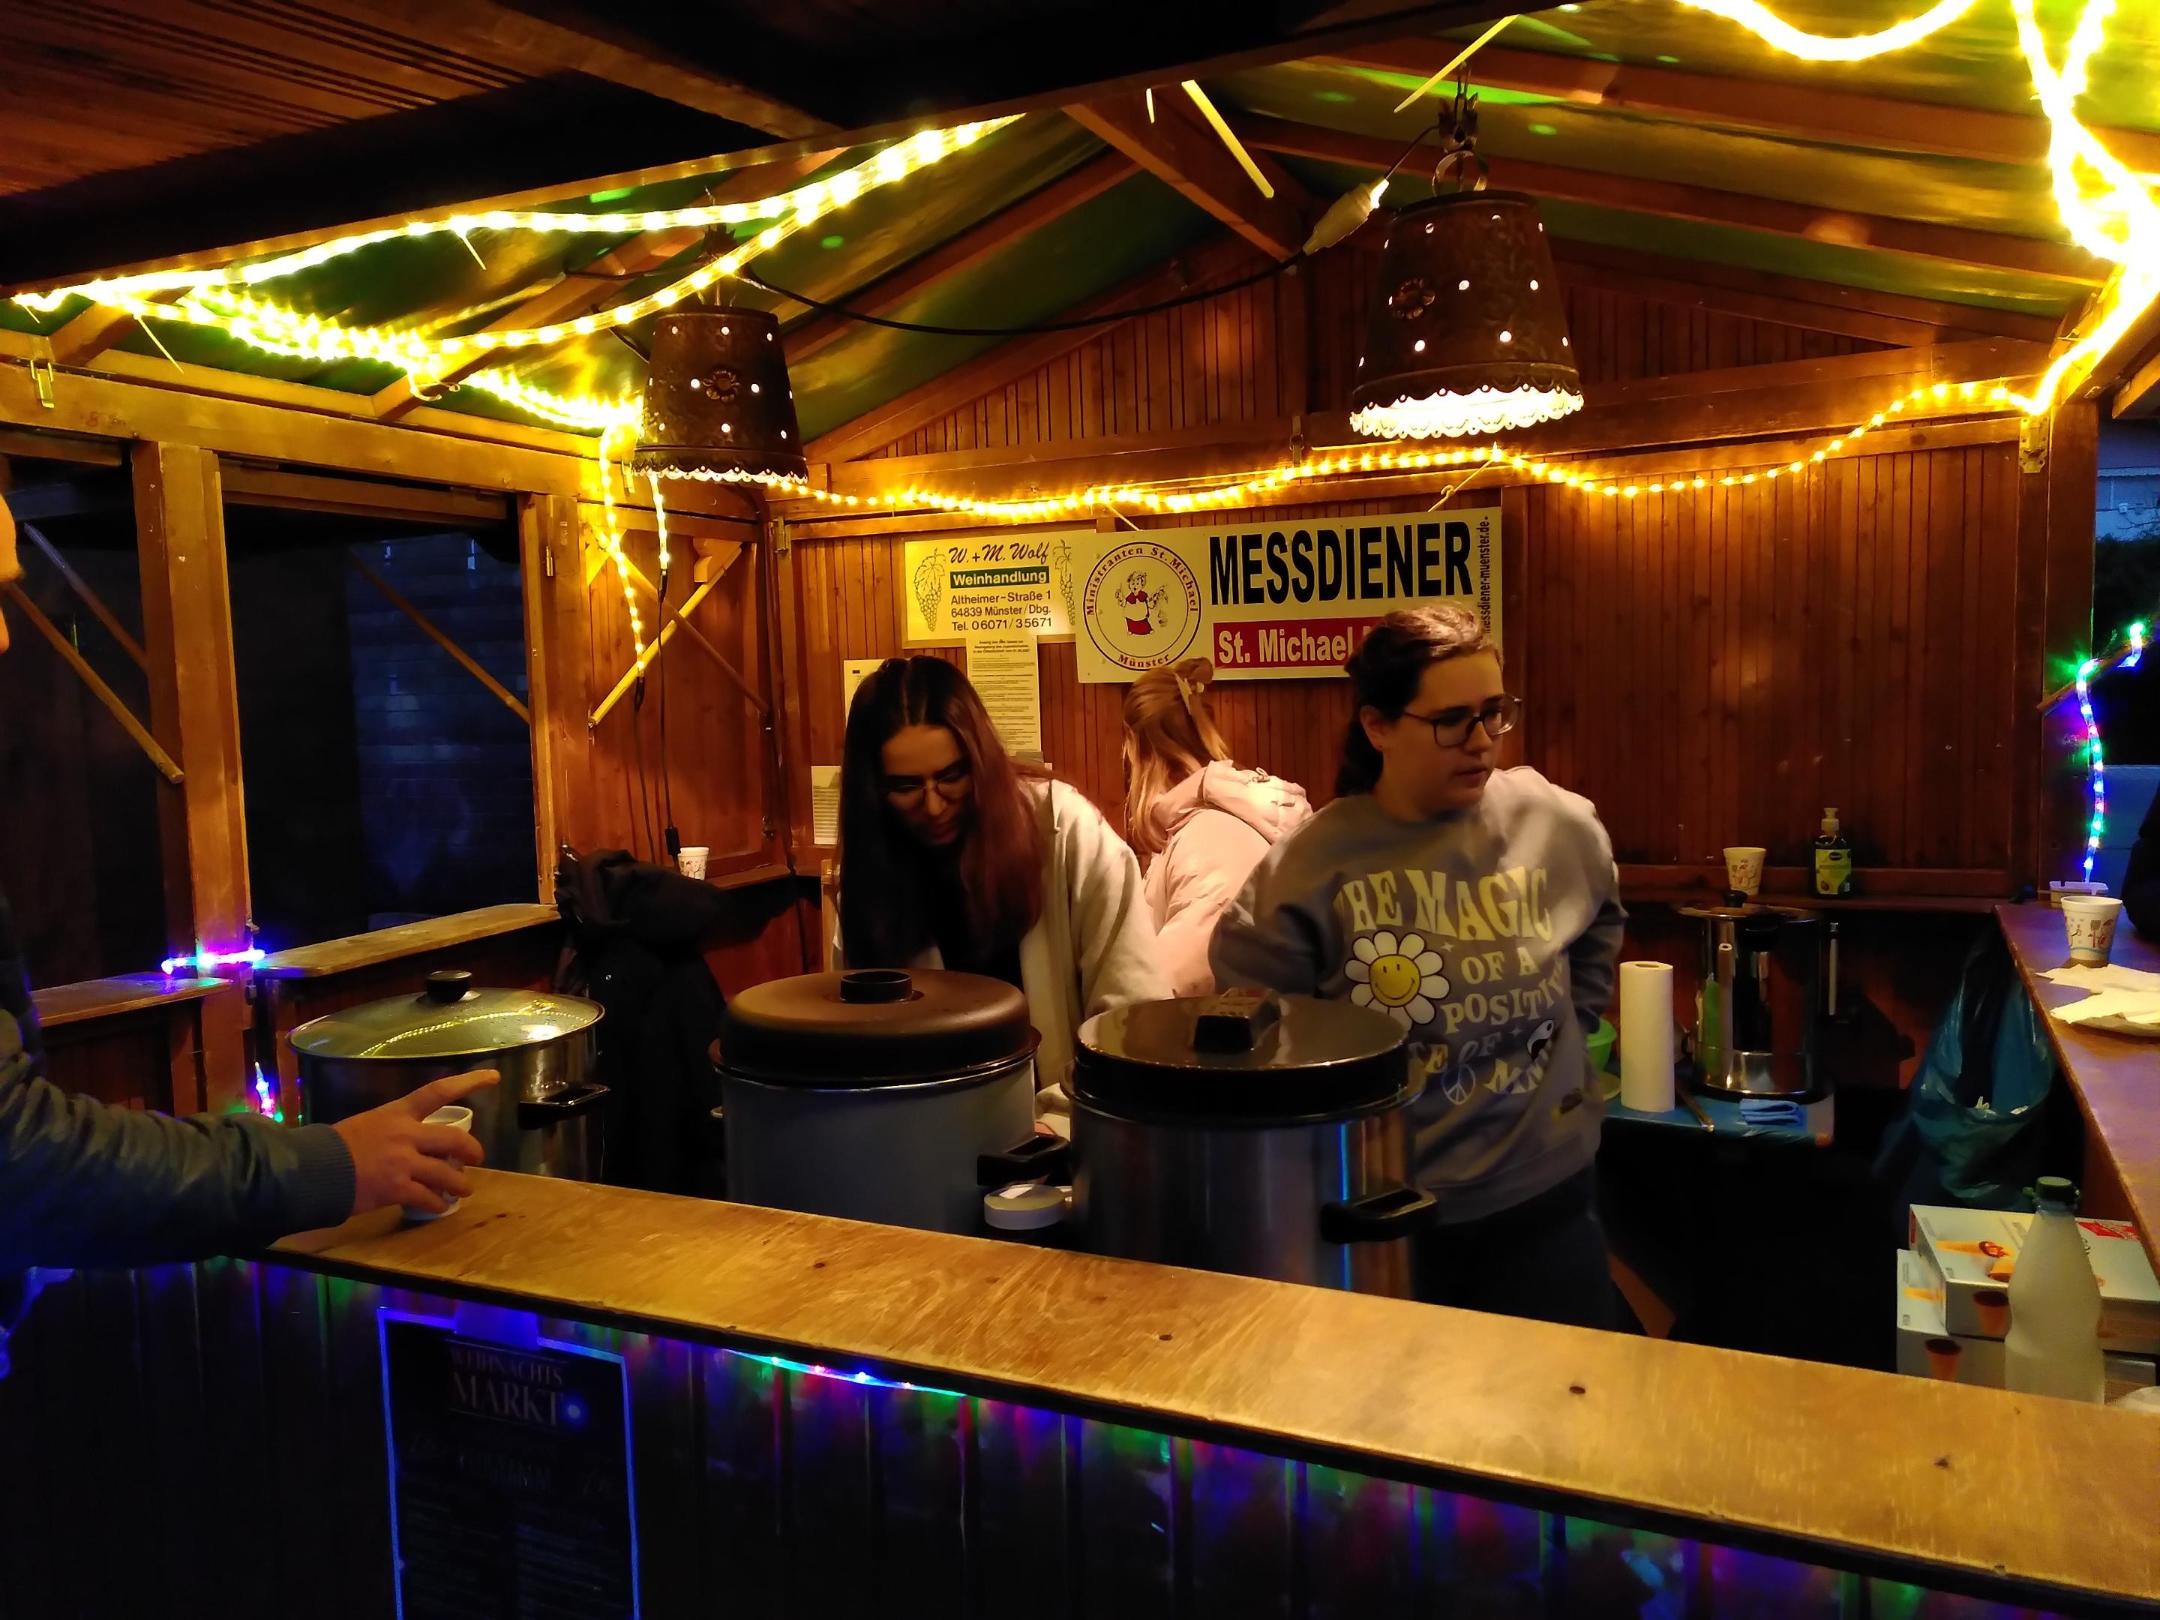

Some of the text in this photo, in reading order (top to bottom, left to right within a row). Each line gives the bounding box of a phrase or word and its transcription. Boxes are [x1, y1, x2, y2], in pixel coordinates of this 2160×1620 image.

[948, 547, 969, 564] W.
[982, 544, 1006, 561] M.
[1009, 542, 1049, 565] Wolf
[1209, 521, 1473, 606] MESSDIENER
[952, 570, 1047, 586] Weinhandlung
[1086, 547, 1198, 616] Ministranten St. Michael
[1046, 590, 1051, 600] 1
[951, 607, 982, 618] 64839
[952, 621, 969, 631] Tel.
[1218, 626, 1353, 664] St. Michael
[1118, 654, 1169, 667] Münster
[1404, 866, 1552, 941] MAGIC
[1461, 951, 1505, 984] OF
[451, 1371, 559, 1426] MARKT
